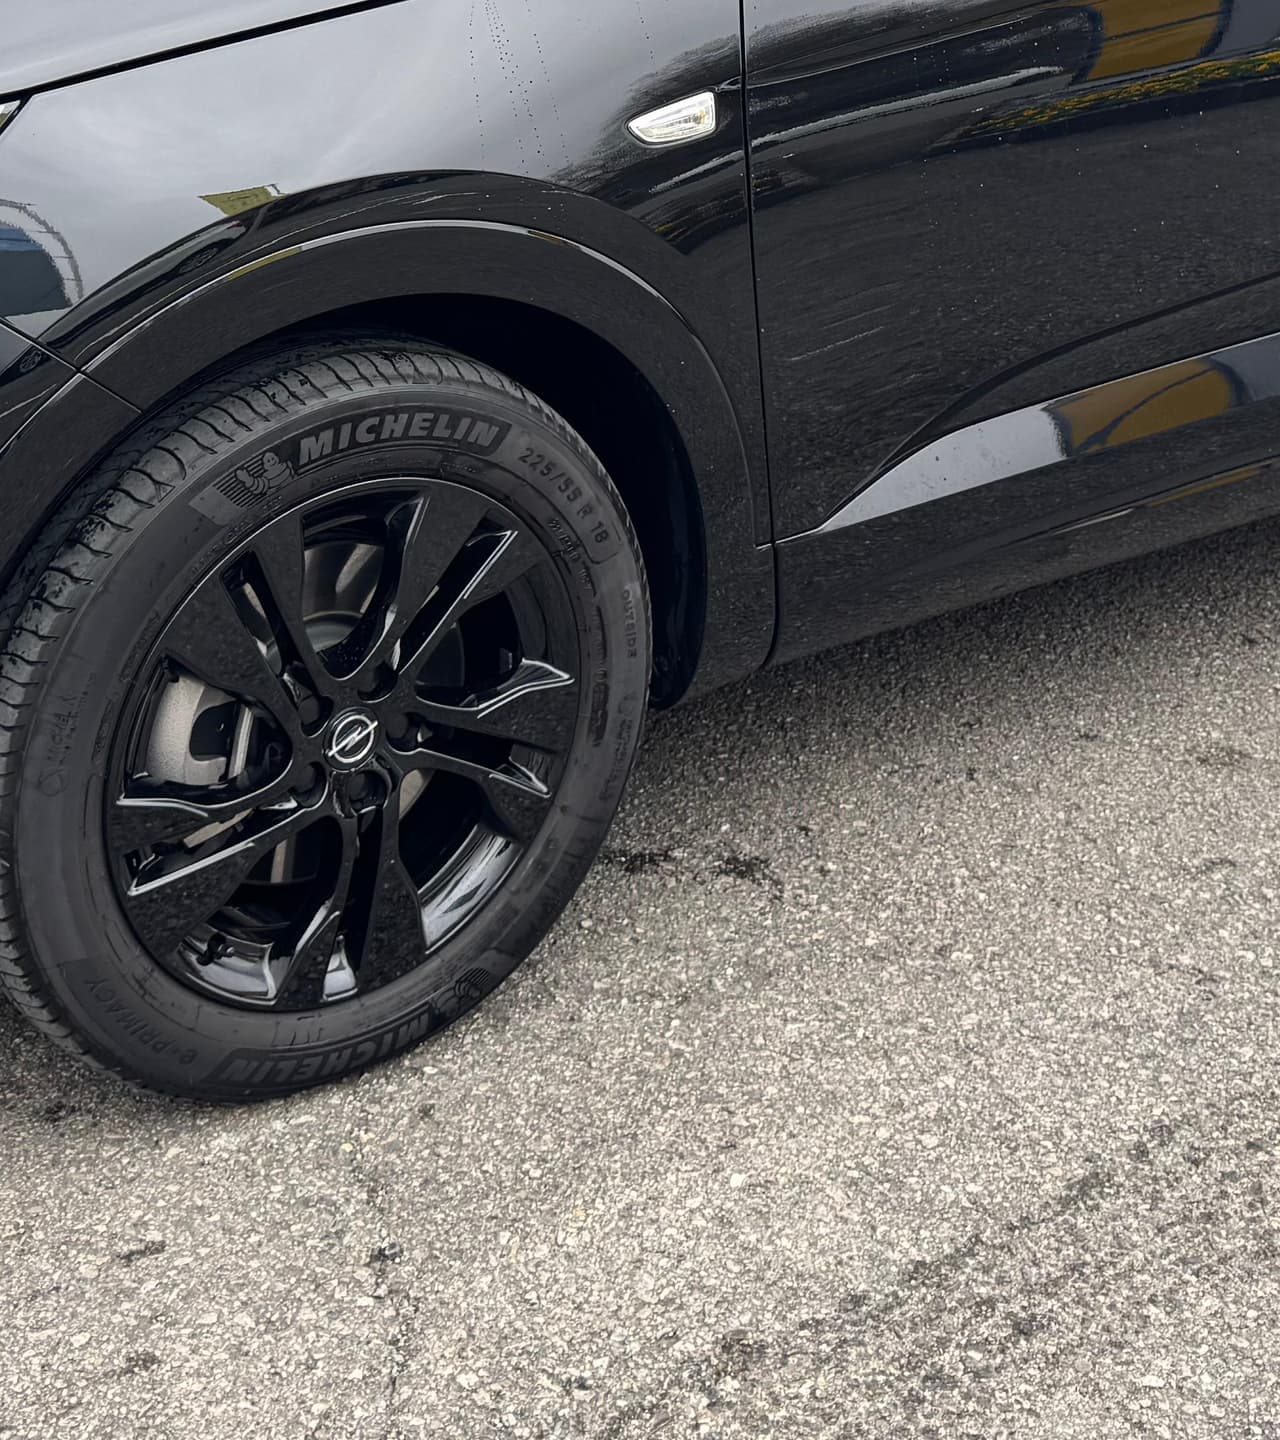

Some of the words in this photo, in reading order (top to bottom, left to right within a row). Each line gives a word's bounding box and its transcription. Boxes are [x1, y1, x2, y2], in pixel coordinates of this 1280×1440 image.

[297, 412, 500, 464] MICHELIN
[518, 447, 583, 503] 225/55
[590, 521, 611, 545] 18
